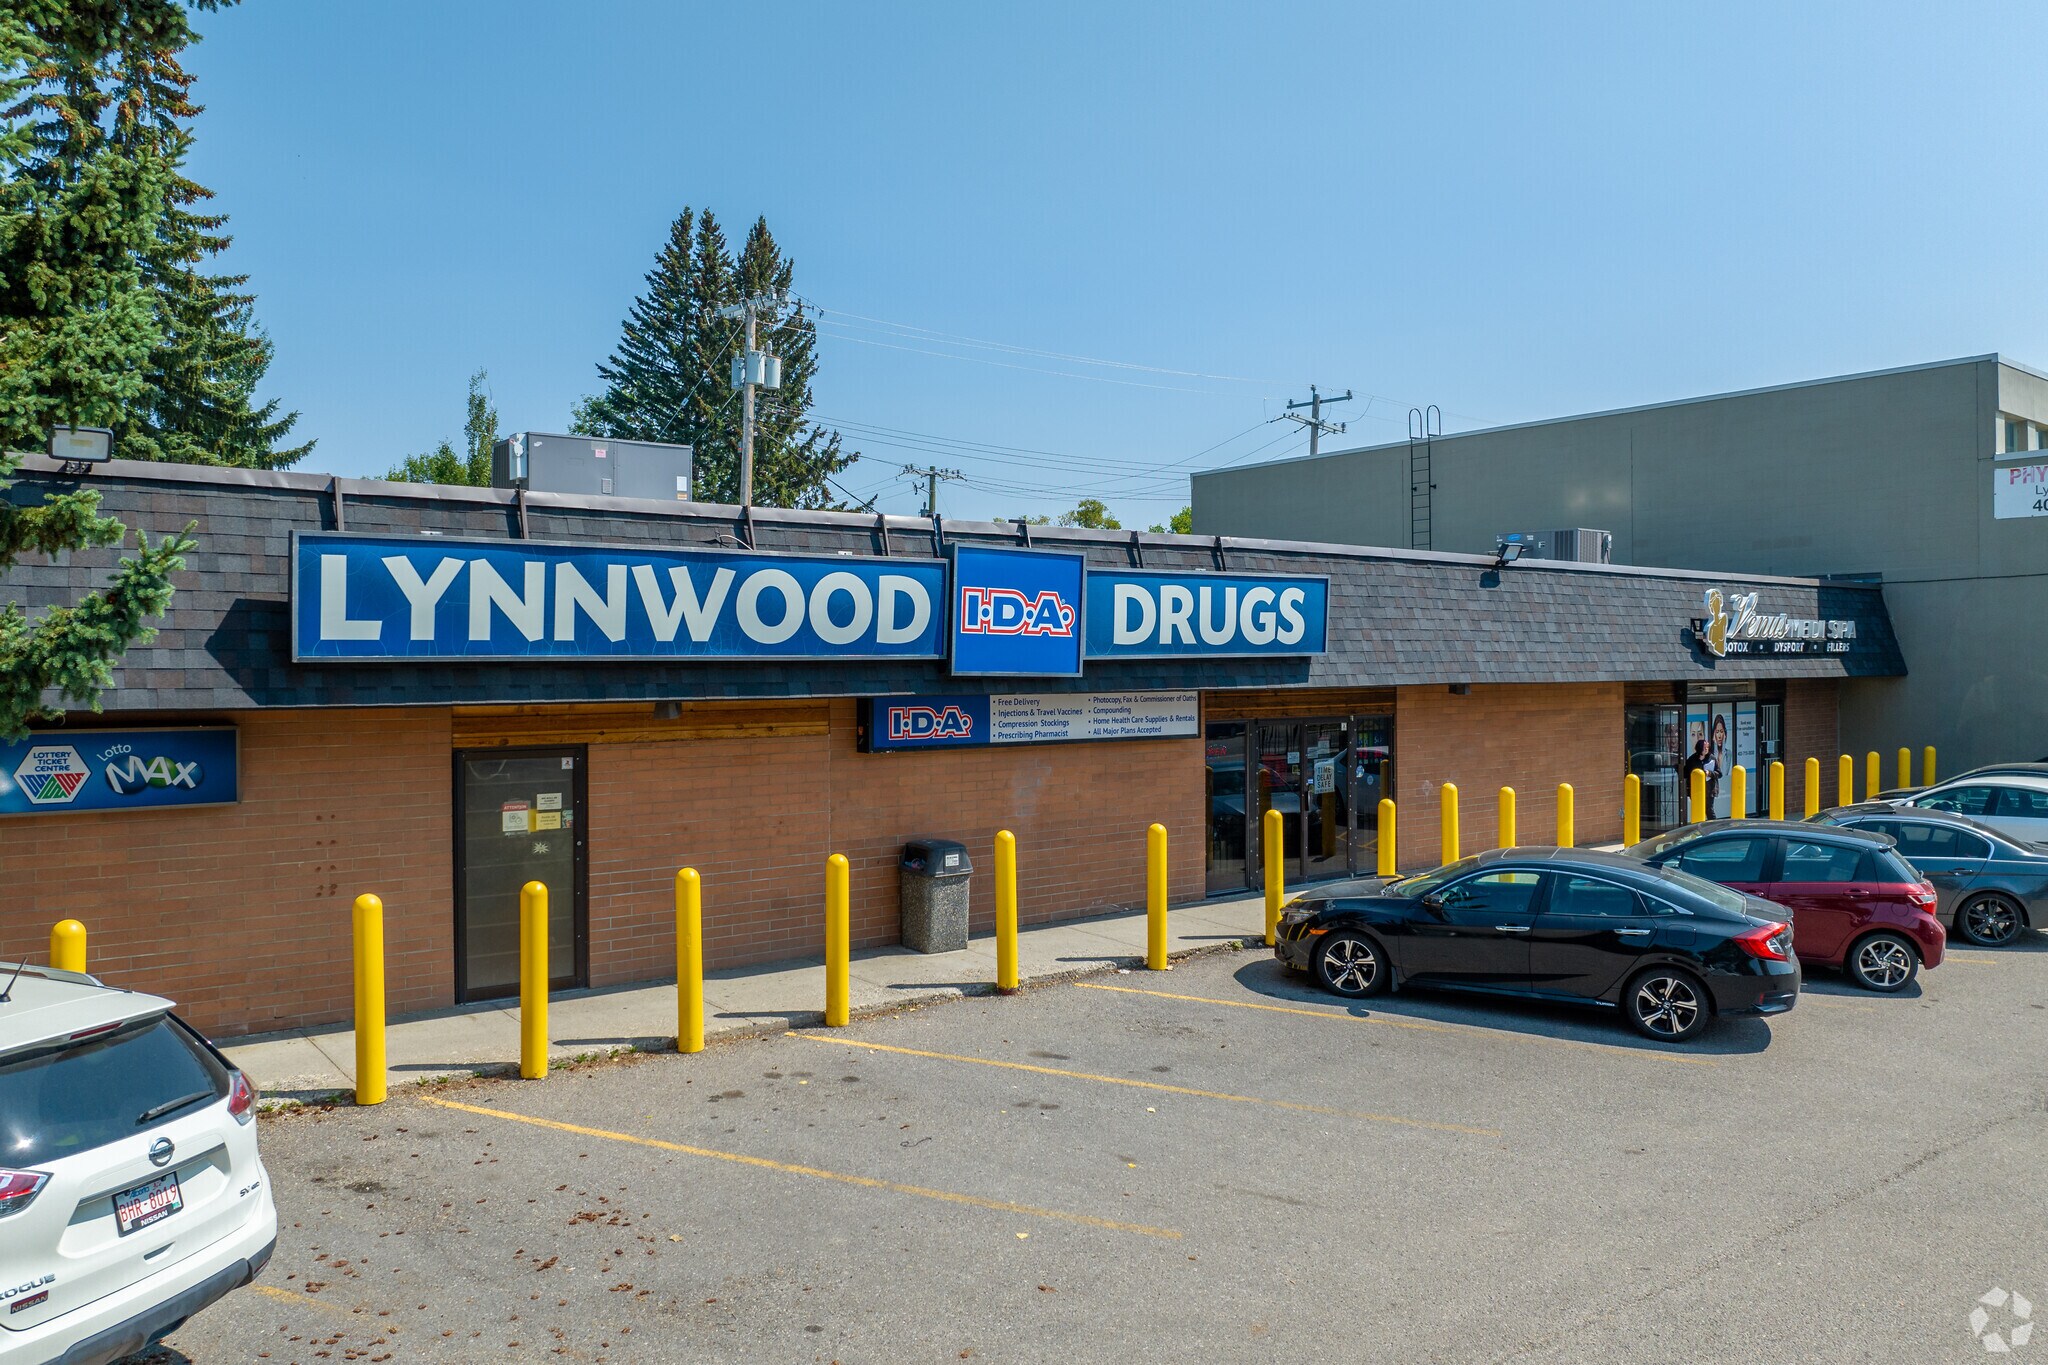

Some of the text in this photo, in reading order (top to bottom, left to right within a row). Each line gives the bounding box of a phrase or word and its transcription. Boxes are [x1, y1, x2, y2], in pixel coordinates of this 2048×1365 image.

[320, 554, 931, 645] LYNNWOOD
[1113, 583, 1305, 645] DRUGS
[1788, 619, 1826, 639] MEDI
[1827, 619, 1856, 639] SPA
[1774, 642, 1805, 652] DYSPORT
[1826, 642, 1850, 652] FILLERS
[998, 698, 1041, 707] Free Delivery
[1093, 694, 1196, 704] Photocopy, Fax & Commissioner of Oaths
[998, 709, 1029, 718] Injections
[1036, 708, 1056, 716] Travel
[1057, 708, 1083, 716] Vaccines
[1093, 706, 1131, 714] Compounding
[998, 719, 1070, 729] Compression Stockings
[1112, 716, 1130, 724] Health
[1145, 715, 1168, 724] Supplies
[1175, 714, 1195, 722] Rentals
[998, 730, 1069, 740] Prescribing Pharmacist
[1102, 727, 1119, 736] Major
[1136, 726, 1161, 734] Accepted
[33, 751, 71, 759] LOTTERY
[97, 743, 131, 762] Lotto
[37, 758, 68, 766] TICKET
[35, 765, 71, 773] CENTRE
[1317, 766, 1331, 774] TIME
[105, 755, 198, 795] MAX
[1316, 773, 1332, 782] DELAY
[1317, 780, 1331, 789] SAFE
[119, 1184, 177, 1223] BHR-8019
[140, 1210, 168, 1227] NISSAN
[12, 1294, 48, 1312] NISSAN
